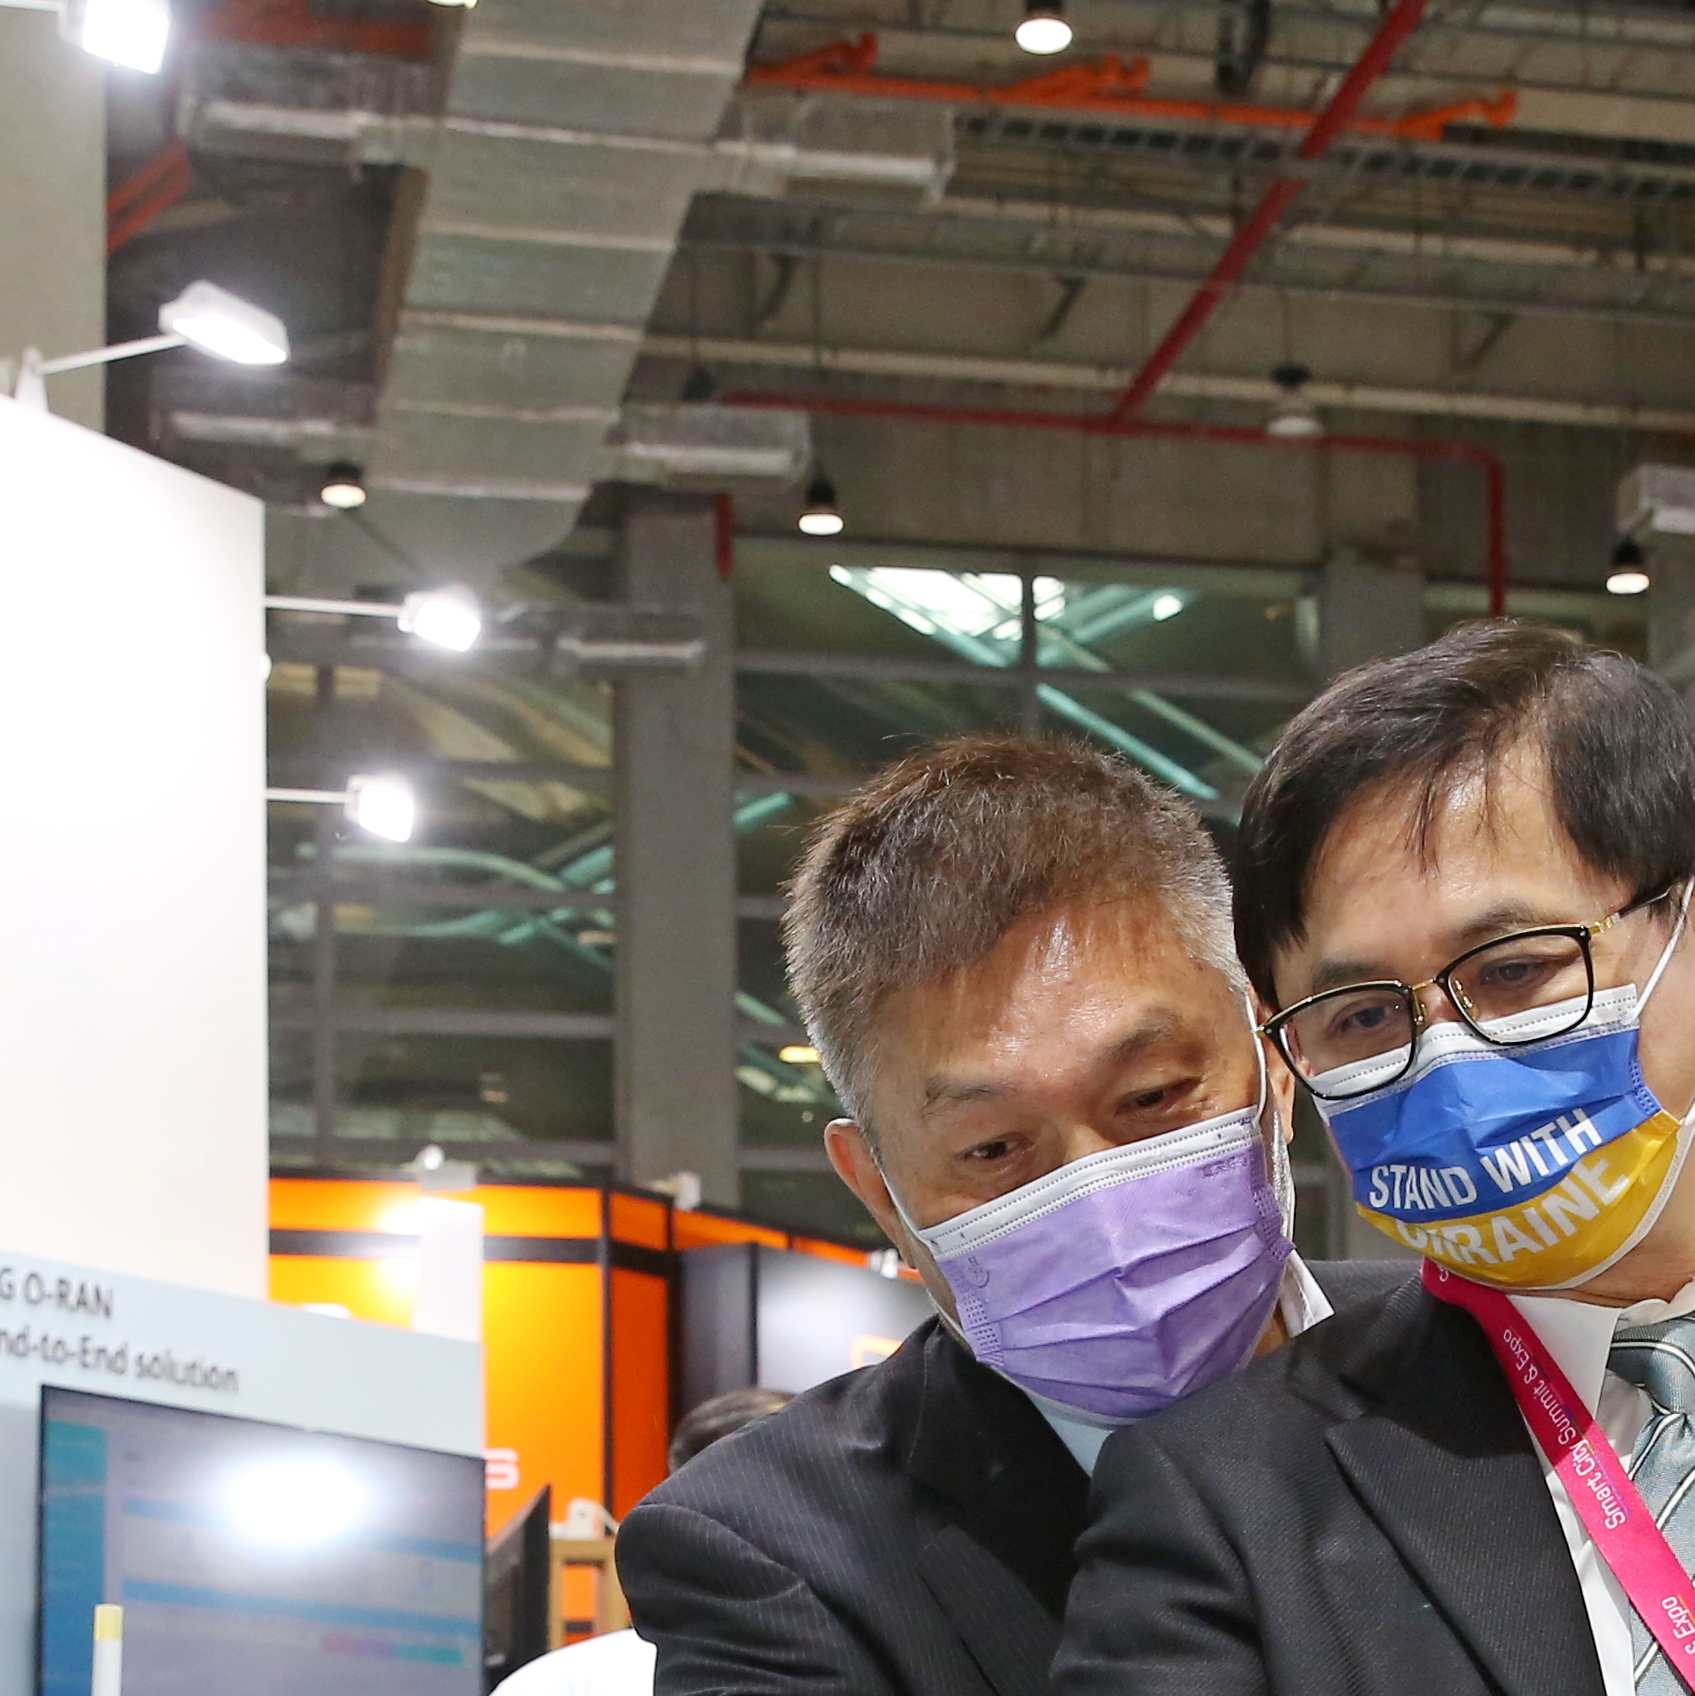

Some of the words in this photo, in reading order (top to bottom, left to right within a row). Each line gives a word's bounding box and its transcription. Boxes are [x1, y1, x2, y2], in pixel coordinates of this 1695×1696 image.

[1369, 1164, 1478, 1210] STAND
[1479, 1108, 1603, 1193] WITH
[23, 1270, 114, 1320] O-RAN
[1503, 1328, 1530, 1371] Expo
[135, 1350, 240, 1395] solution
[1523, 1366, 1538, 1385] &
[1533, 1380, 1578, 1445] Summit
[1570, 1438, 1595, 1477] City
[1586, 1471, 1627, 1530] Smart
[1661, 1596, 1695, 1639] Expo
